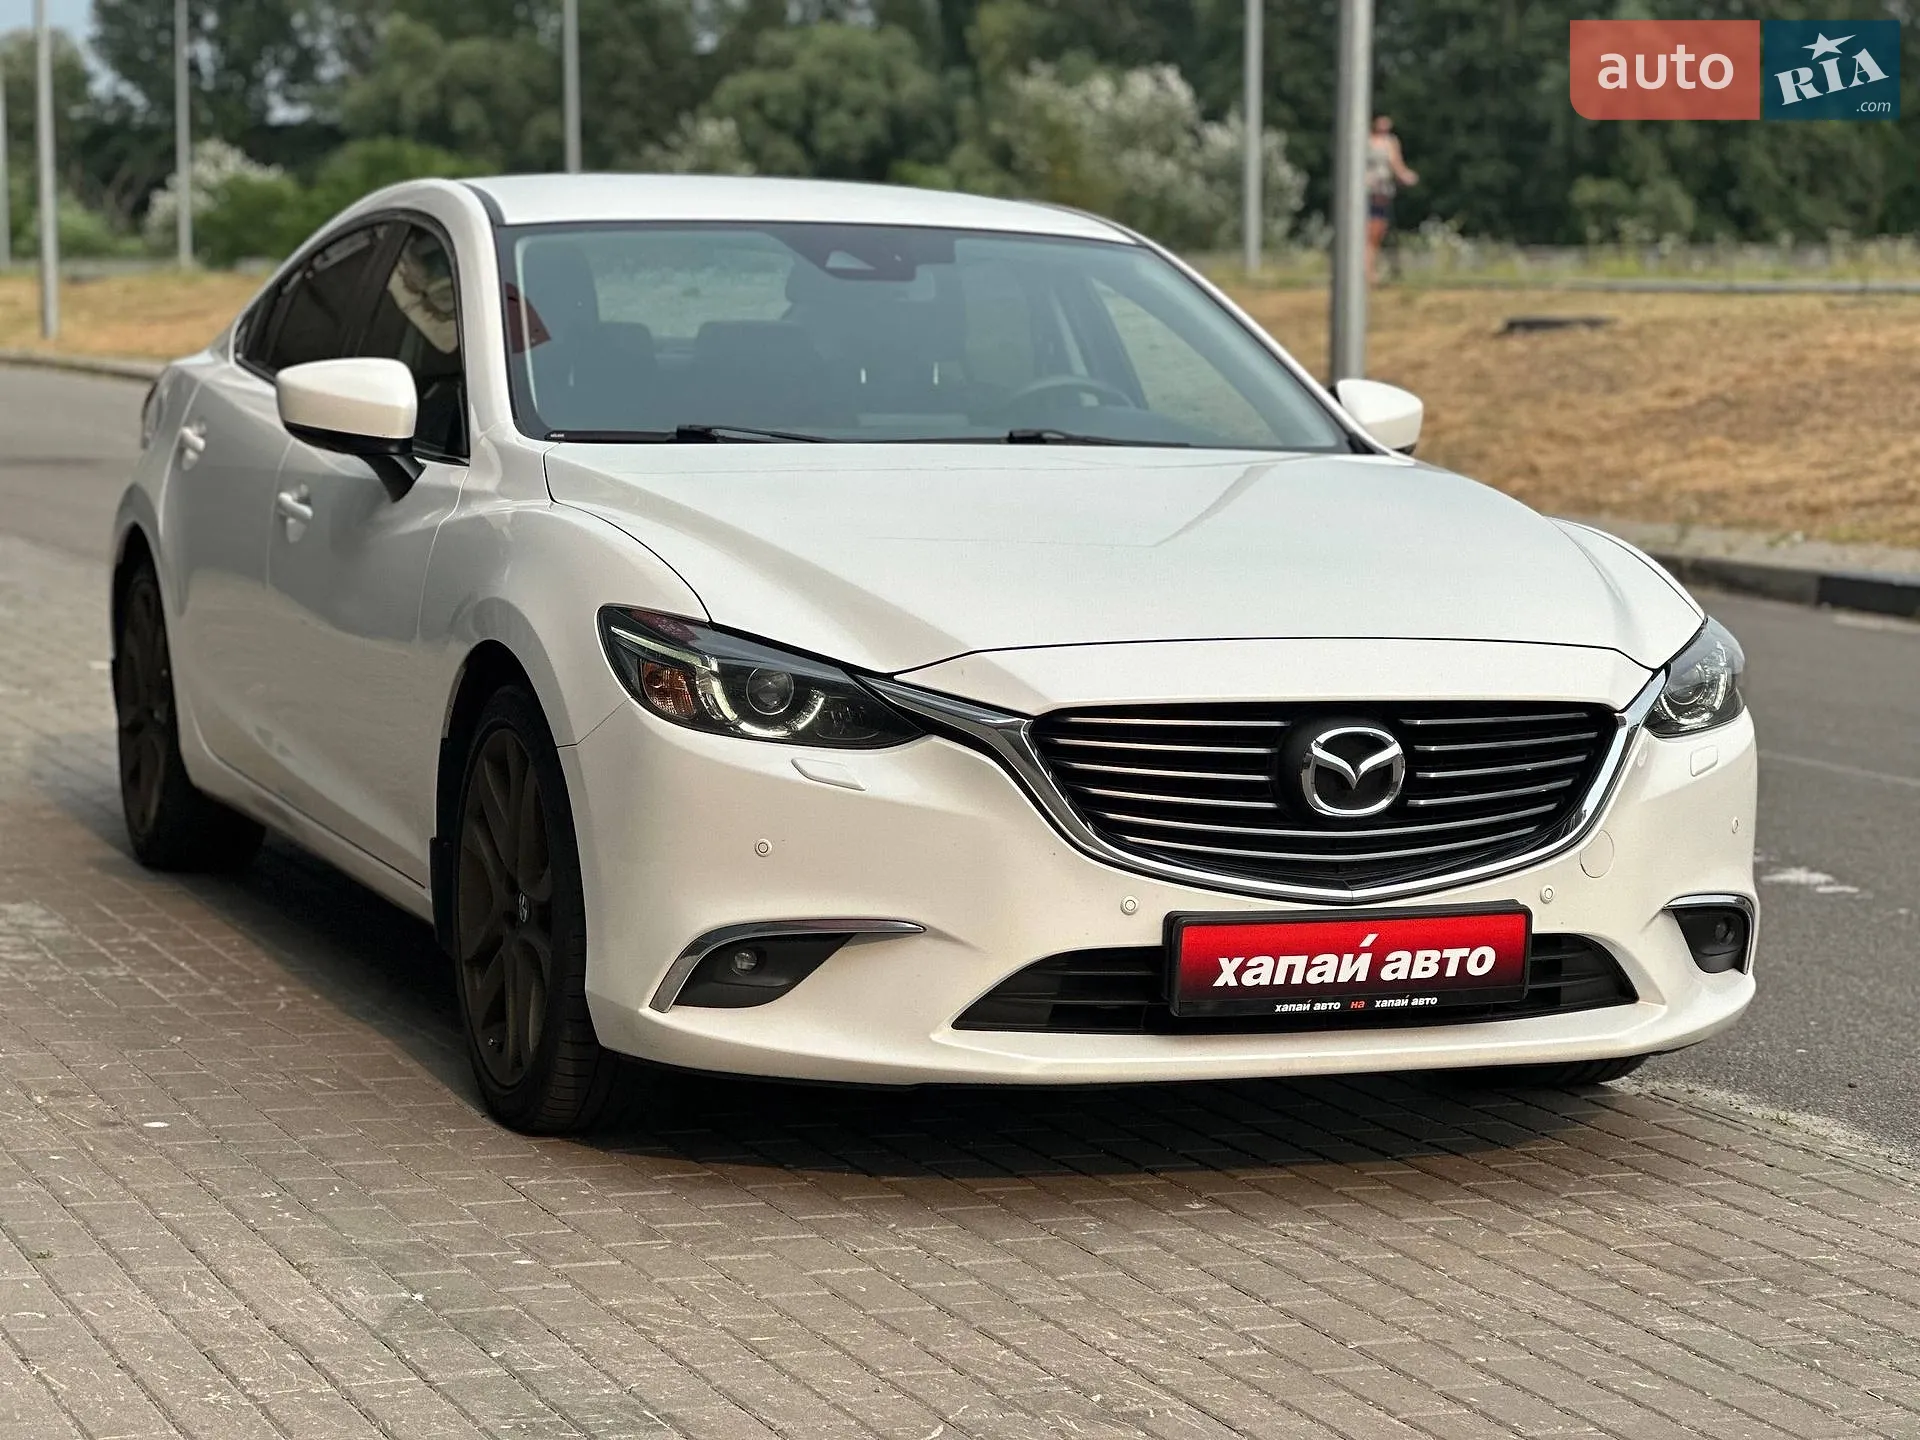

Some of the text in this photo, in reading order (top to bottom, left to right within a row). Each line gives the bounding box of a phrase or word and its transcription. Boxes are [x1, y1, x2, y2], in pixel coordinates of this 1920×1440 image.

[1380, 945, 1496, 981] авто
[1313, 1001, 1341, 1011] авто
[1350, 1000, 1365, 1009] на
[1411, 996, 1438, 1006] авто
